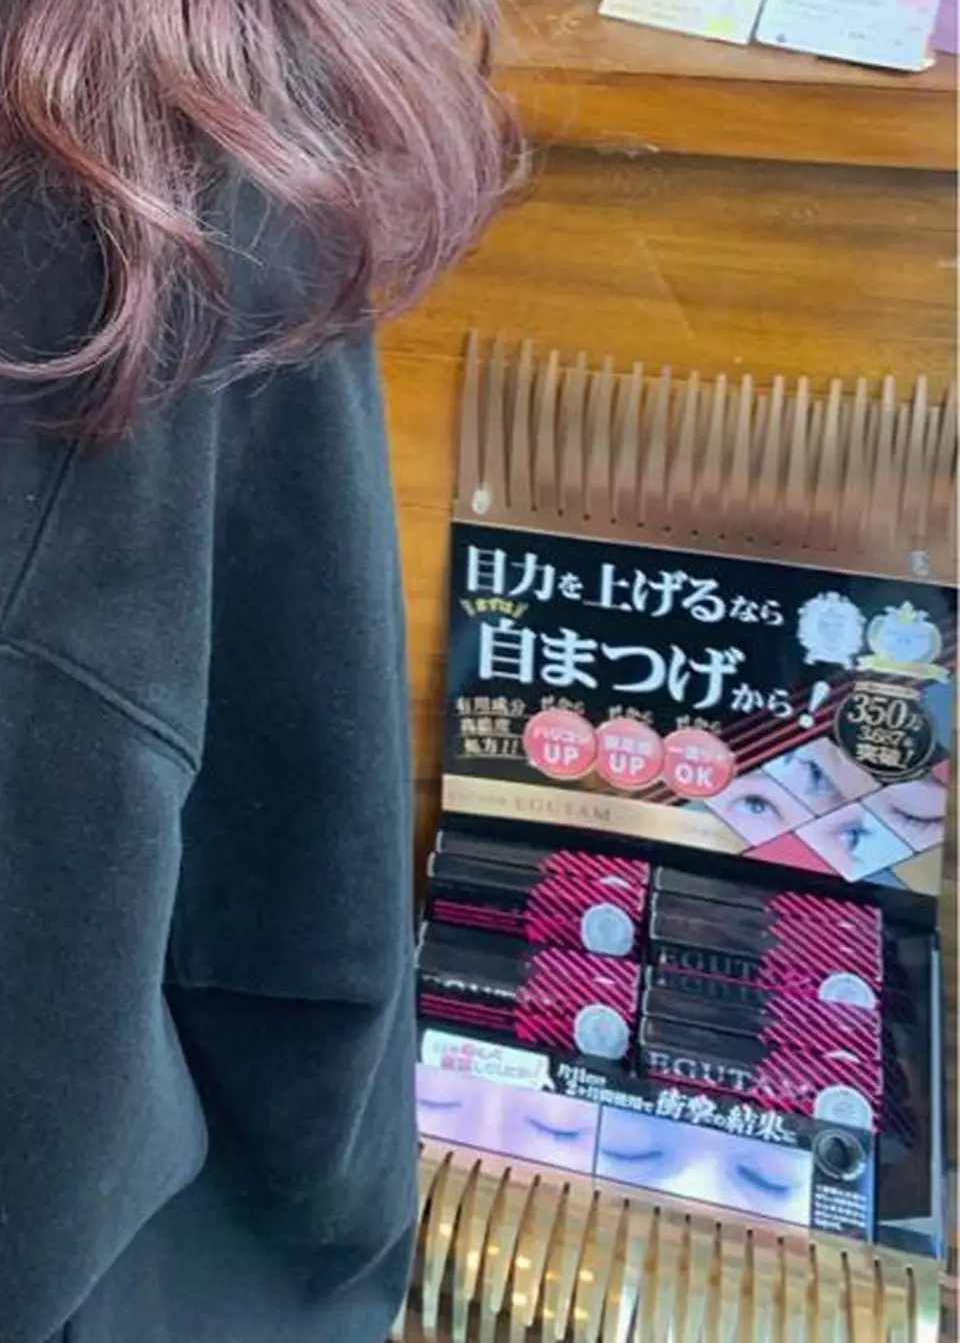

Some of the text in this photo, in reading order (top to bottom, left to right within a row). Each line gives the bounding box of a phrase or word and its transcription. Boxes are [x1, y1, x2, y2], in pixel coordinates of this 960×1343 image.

[467, 544, 785, 627] 目力を上げるなら
[545, 743, 580, 766] UP
[609, 752, 645, 776] UP
[675, 763, 713, 787] OK
